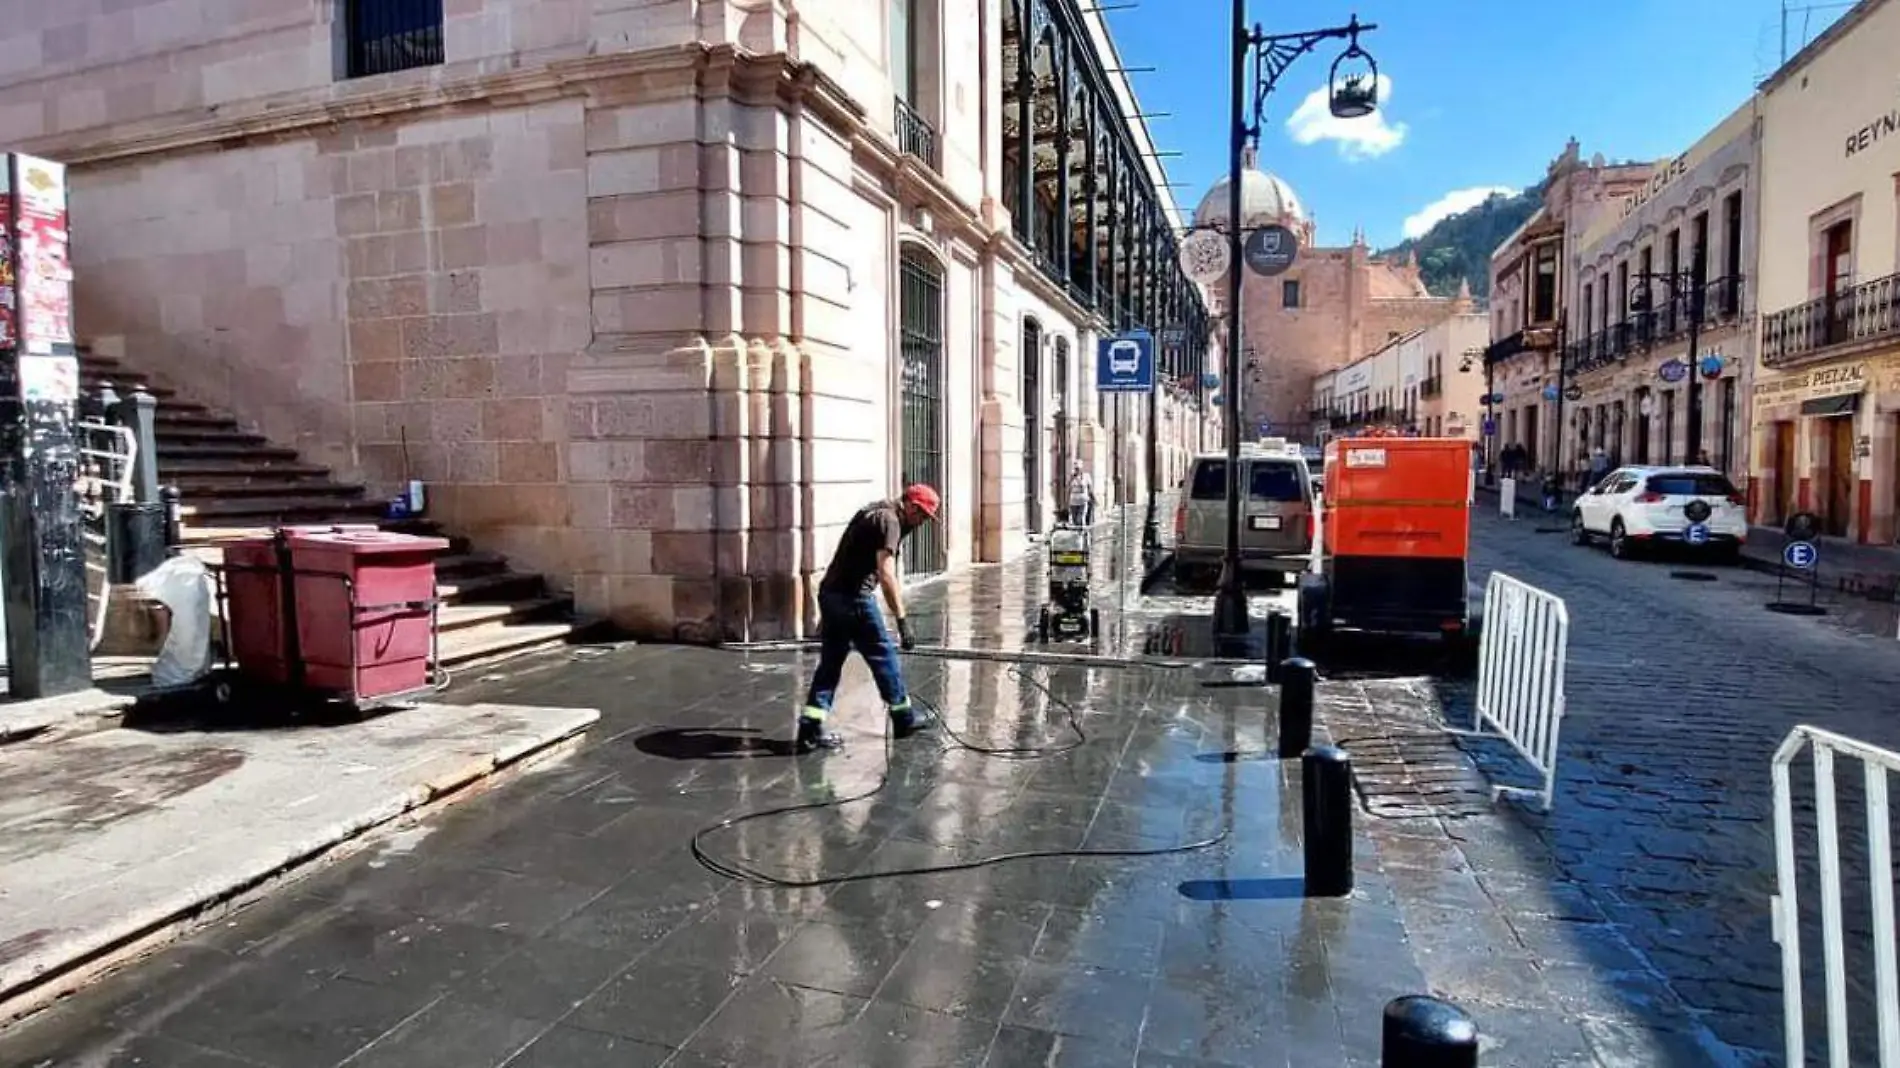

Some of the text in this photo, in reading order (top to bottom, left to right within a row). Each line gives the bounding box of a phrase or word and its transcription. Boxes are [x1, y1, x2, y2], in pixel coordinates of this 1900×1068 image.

[1845, 107, 1900, 158] REYN
[1690, 525, 1702, 542] E
[1794, 546, 1808, 564] E
